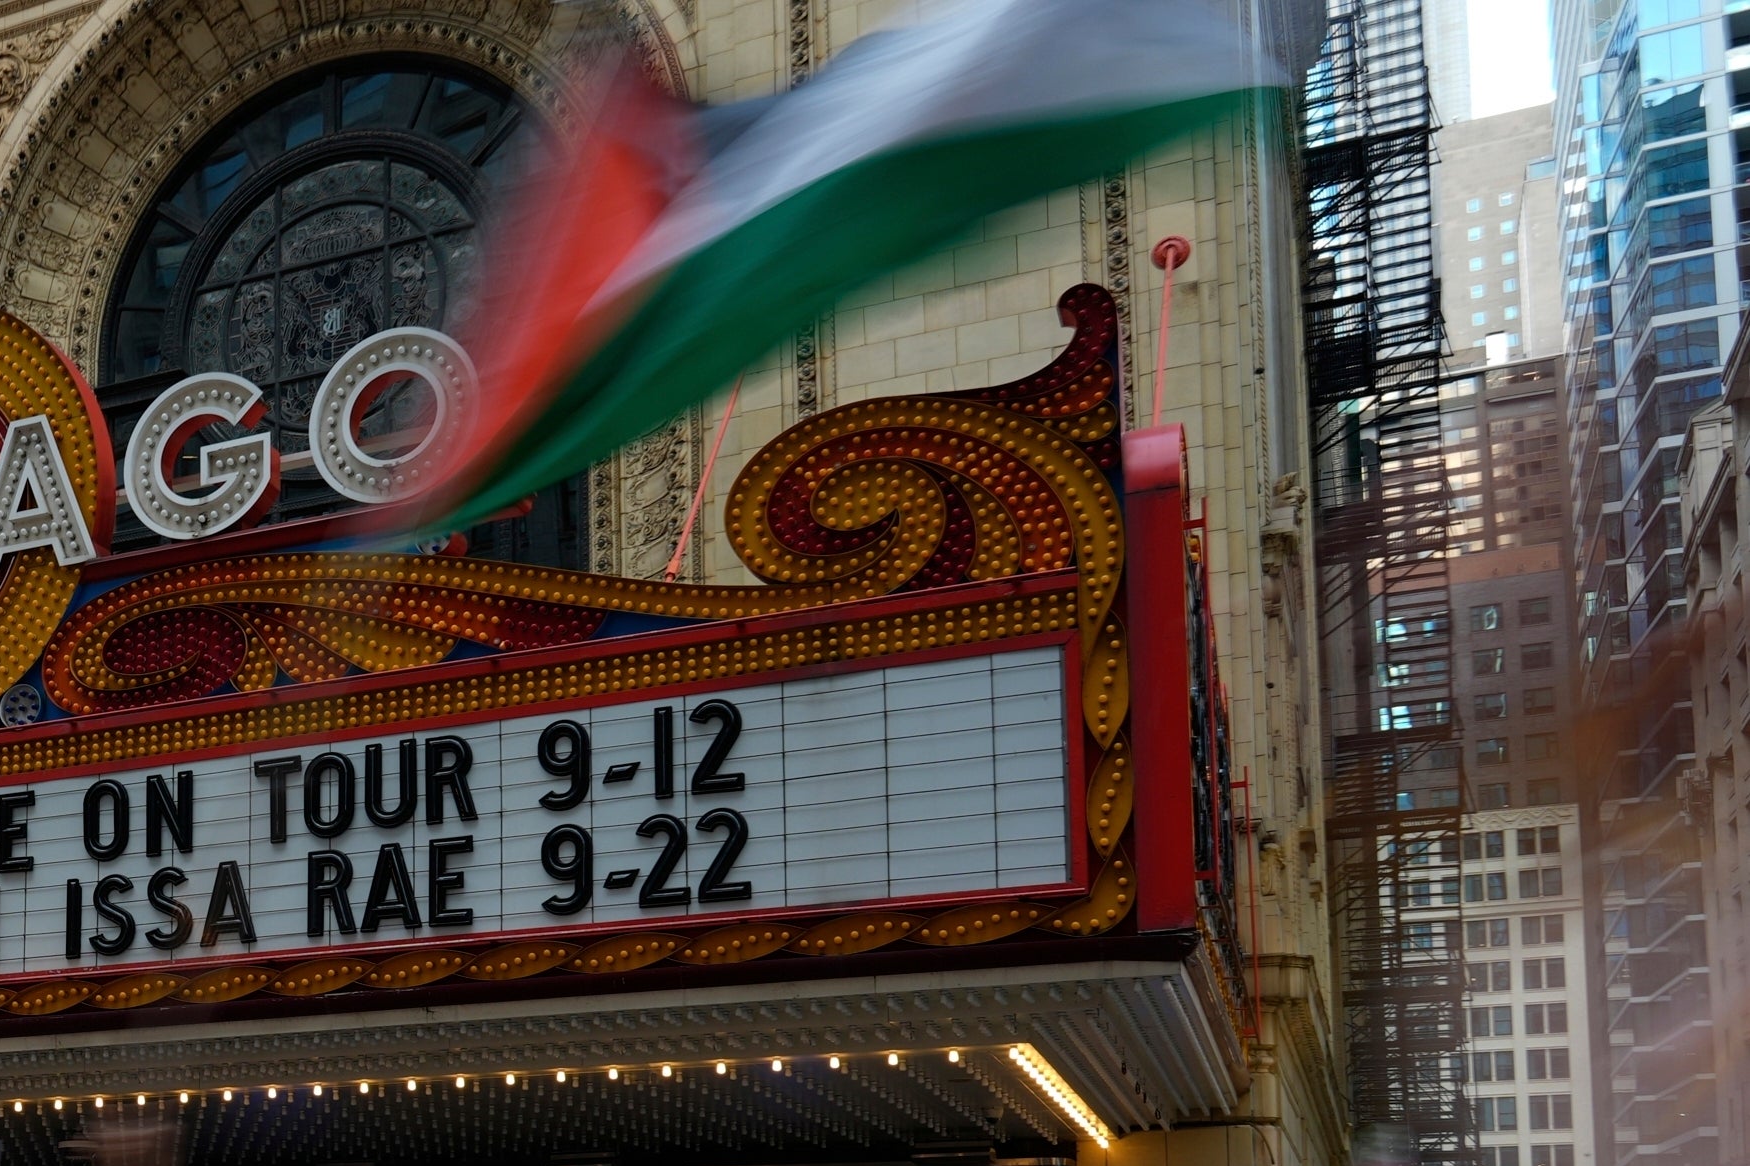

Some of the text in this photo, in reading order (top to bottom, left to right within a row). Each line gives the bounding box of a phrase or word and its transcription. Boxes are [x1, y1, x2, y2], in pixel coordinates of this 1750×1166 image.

[82, 769, 194, 862] ON
[253, 734, 479, 844] TOUR
[536, 698, 746, 811] 9-12
[65, 859, 258, 960] ISSA
[307, 834, 475, 938] RAE
[540, 807, 753, 916] 9-22
